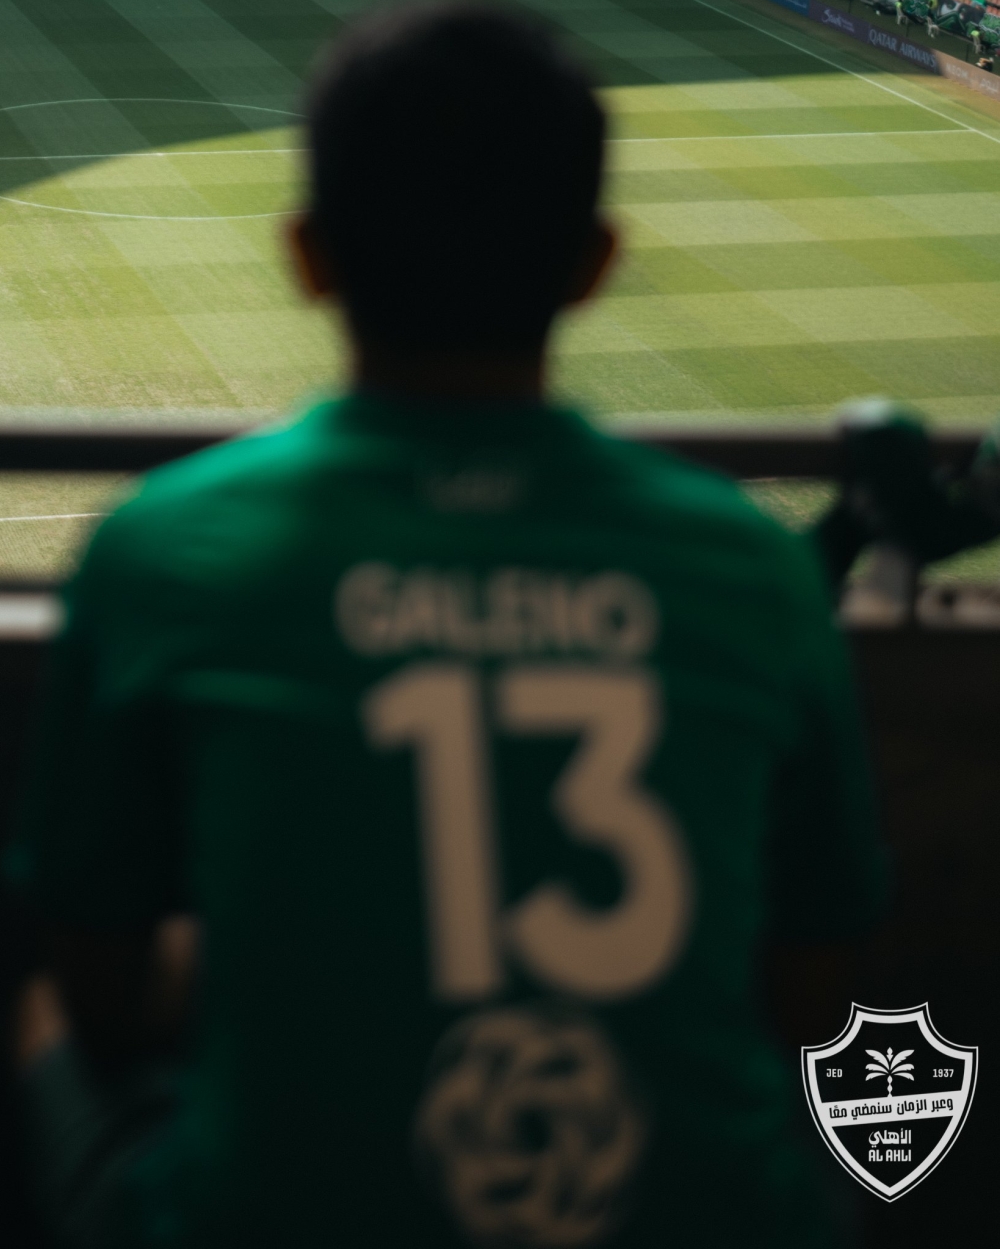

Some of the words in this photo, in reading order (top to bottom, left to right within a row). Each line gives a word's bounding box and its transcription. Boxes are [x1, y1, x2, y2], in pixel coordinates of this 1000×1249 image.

[869, 29, 897, 51] QATAR
[899, 43, 936, 68] AIRWAYS
[334, 559, 661, 660] GALENO
[361, 661, 693, 1002] 13
